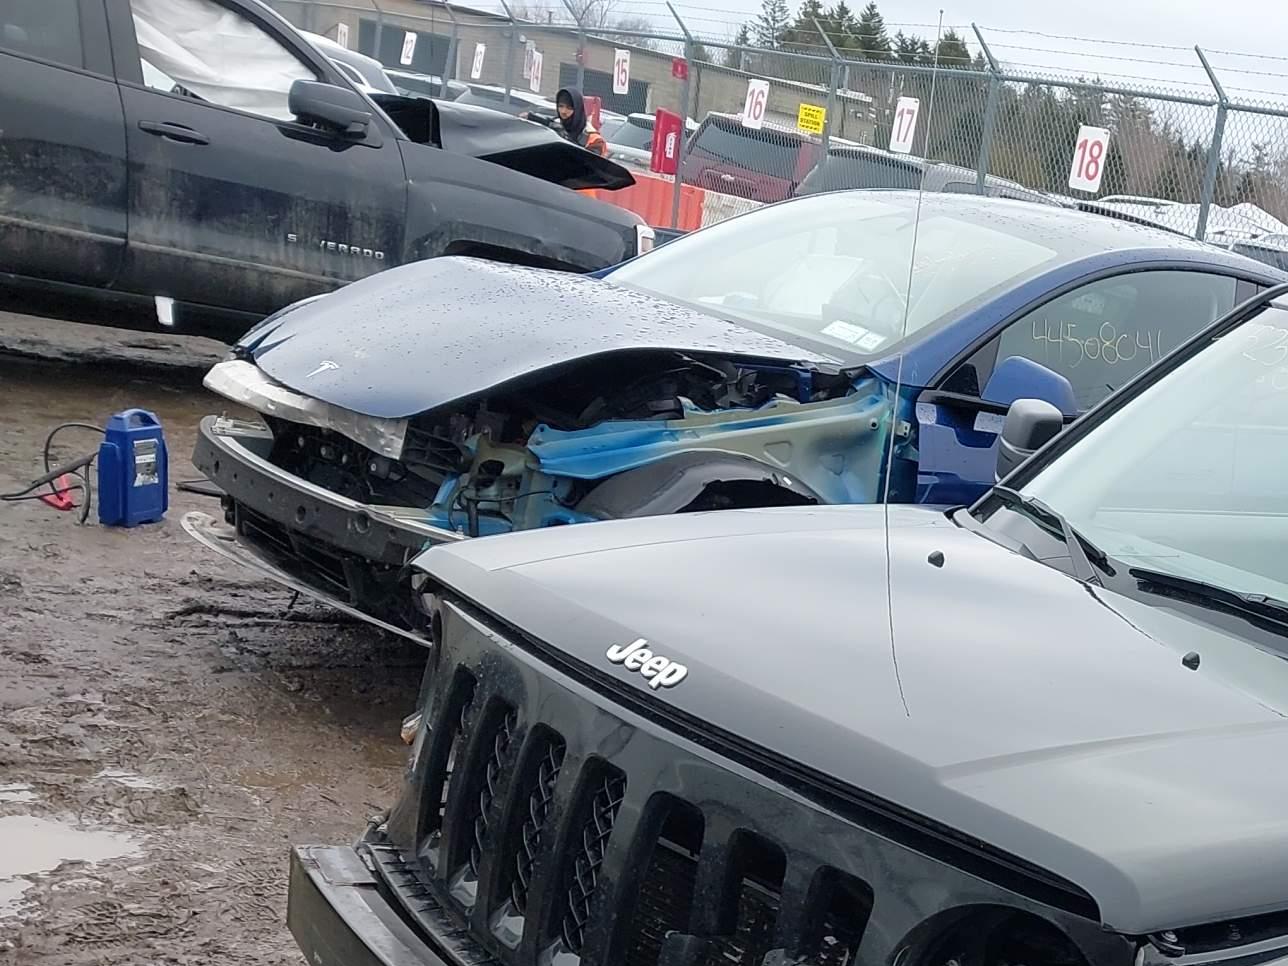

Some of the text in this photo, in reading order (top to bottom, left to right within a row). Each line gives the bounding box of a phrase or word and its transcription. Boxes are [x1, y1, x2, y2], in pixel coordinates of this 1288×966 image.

[615, 59, 627, 86] 15
[749, 87, 765, 121] 16
[896, 107, 915, 143] 17
[1077, 139, 1103, 181] 18
[606, 637, 689, 691] Jeep
